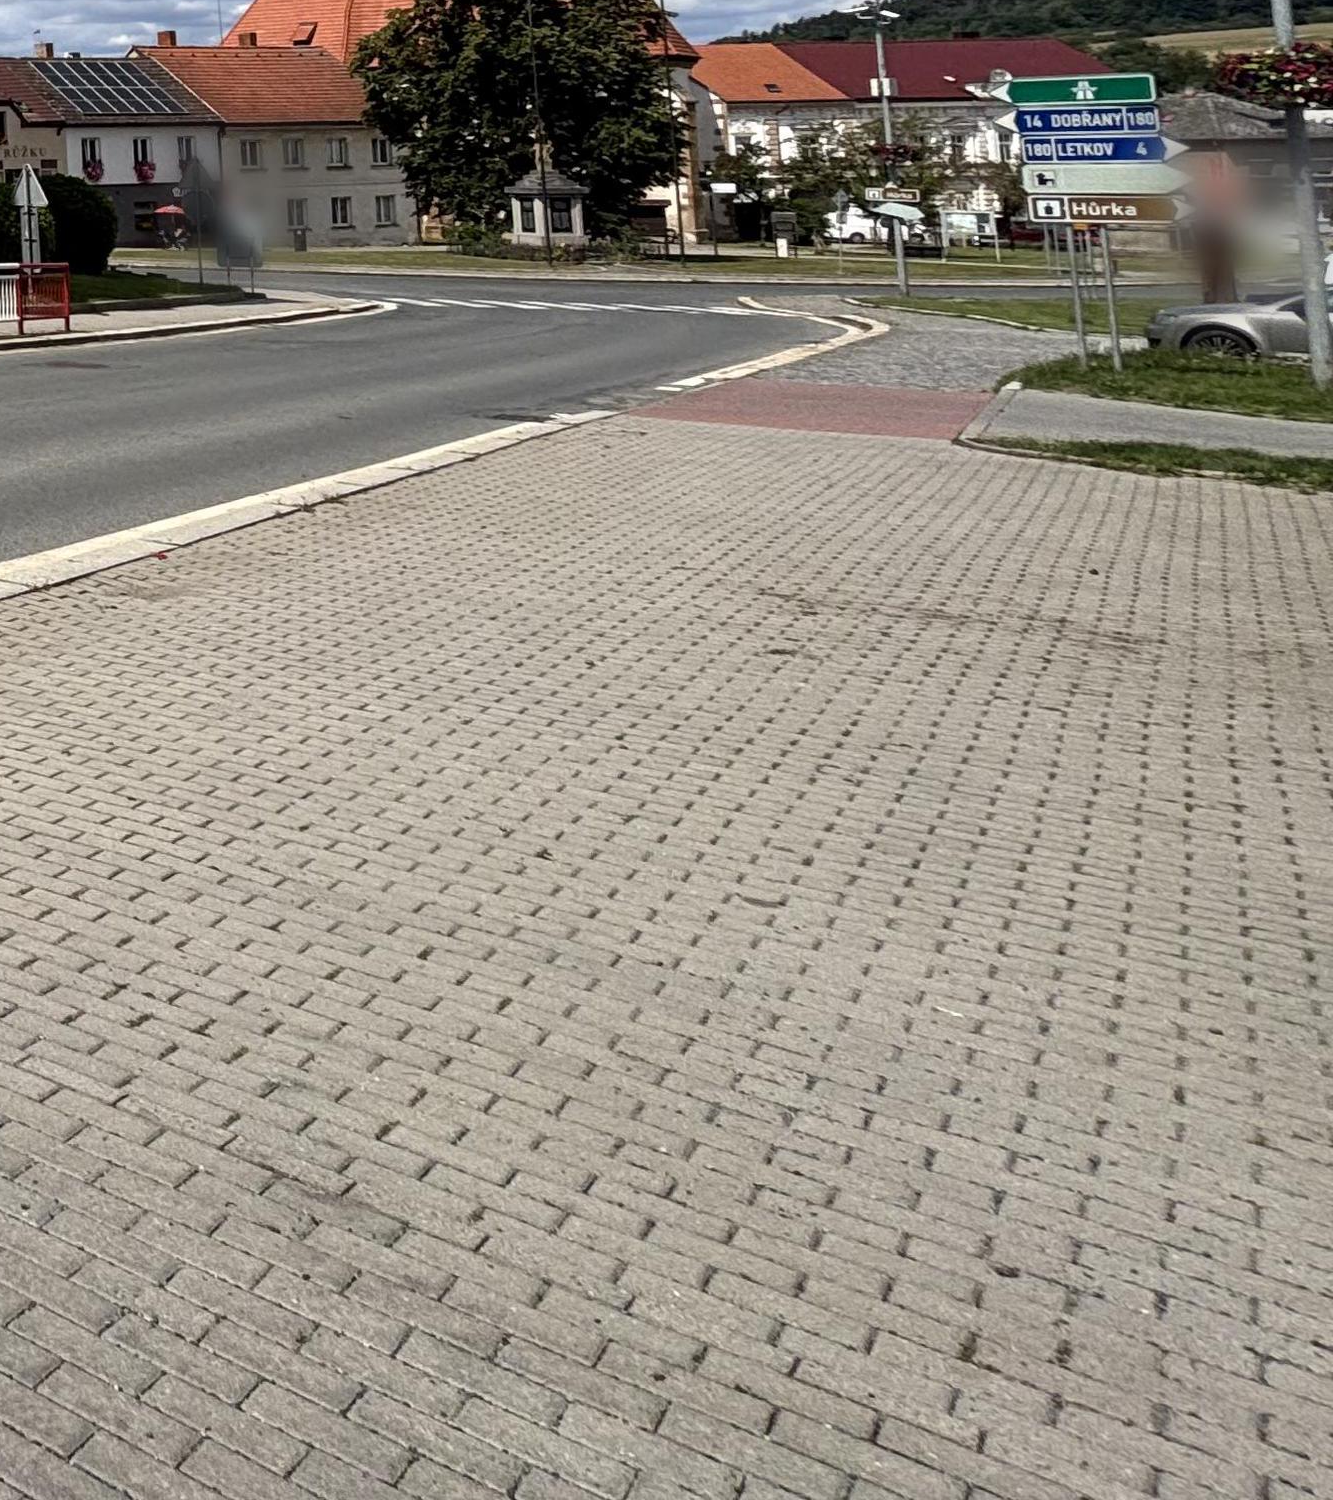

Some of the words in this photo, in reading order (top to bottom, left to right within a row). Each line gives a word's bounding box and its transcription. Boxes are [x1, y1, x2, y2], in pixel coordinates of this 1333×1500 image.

[1024, 115, 1044, 128] 14
[1051, 111, 1122, 128] DOBŘANY
[1128, 111, 1155, 126] 180
[3, 144, 48, 159] RŮŽKU
[1026, 143, 1051, 157] 180
[1058, 142, 1114, 157] LETKOV
[1136, 142, 1148, 156] 4
[1072, 201, 1137, 217] Hůrka
